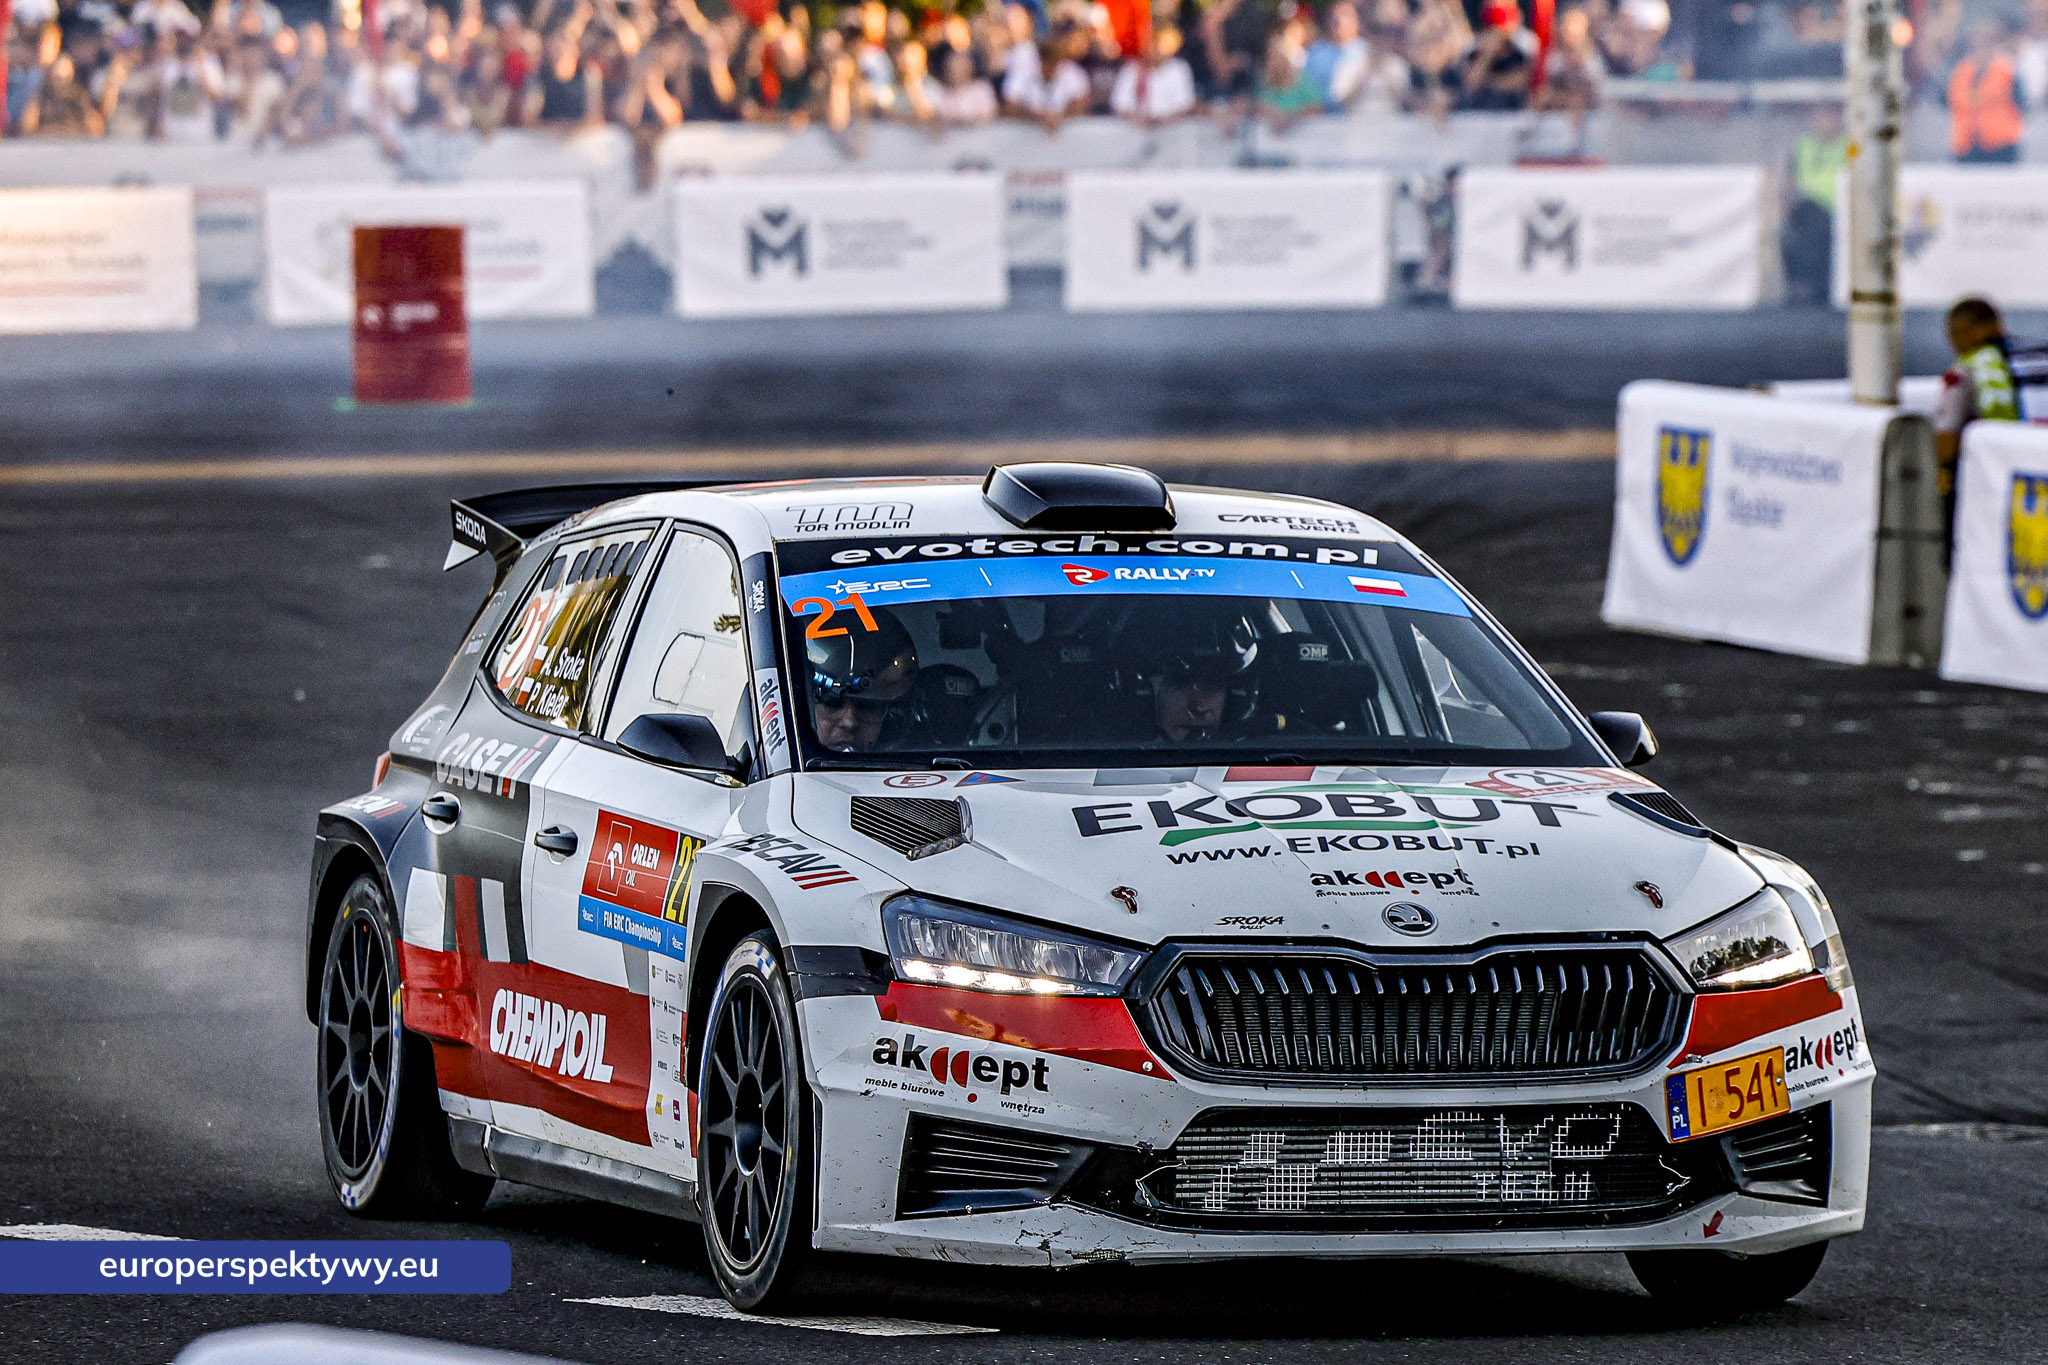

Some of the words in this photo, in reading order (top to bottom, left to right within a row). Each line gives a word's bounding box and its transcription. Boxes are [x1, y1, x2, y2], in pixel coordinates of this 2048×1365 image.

[794, 523, 829, 533] TOR
[834, 520, 910, 531] MODLIN
[1217, 514, 1356, 528] CARTECH
[1289, 524, 1360, 534] EVENTS
[831, 535, 1378, 565] evotech.com.pl
[791, 592, 880, 640] 21
[540, 649, 552, 675] A.
[553, 647, 586, 682] Sroka
[525, 683, 537, 712] P.
[535, 684, 570, 718] Kielar
[436, 732, 518, 795] CASE
[1503, 770, 1586, 786] 21
[1072, 794, 1578, 838] EKOBUT
[630, 842, 661, 871] ORLEN
[1166, 834, 1541, 865] www.EKOBUT.pl
[625, 869, 637, 887] OIL
[665, 835, 702, 923] 21
[1316, 889, 1348, 898] meble
[1349, 889, 1391, 897] biurowe
[603, 910, 613, 929] FIA
[613, 913, 625, 933] ERC
[625, 916, 662, 948] Championship
[1214, 915, 1286, 926] SROKA
[489, 988, 614, 1084] CHEMPIOIL
[864, 1076, 898, 1089] meble
[900, 1081, 945, 1097] biurowe
[1725, 1057, 1779, 1119] 541
[1000, 1100, 1046, 1115] wnętrza
[1671, 1114, 1688, 1130] PL
